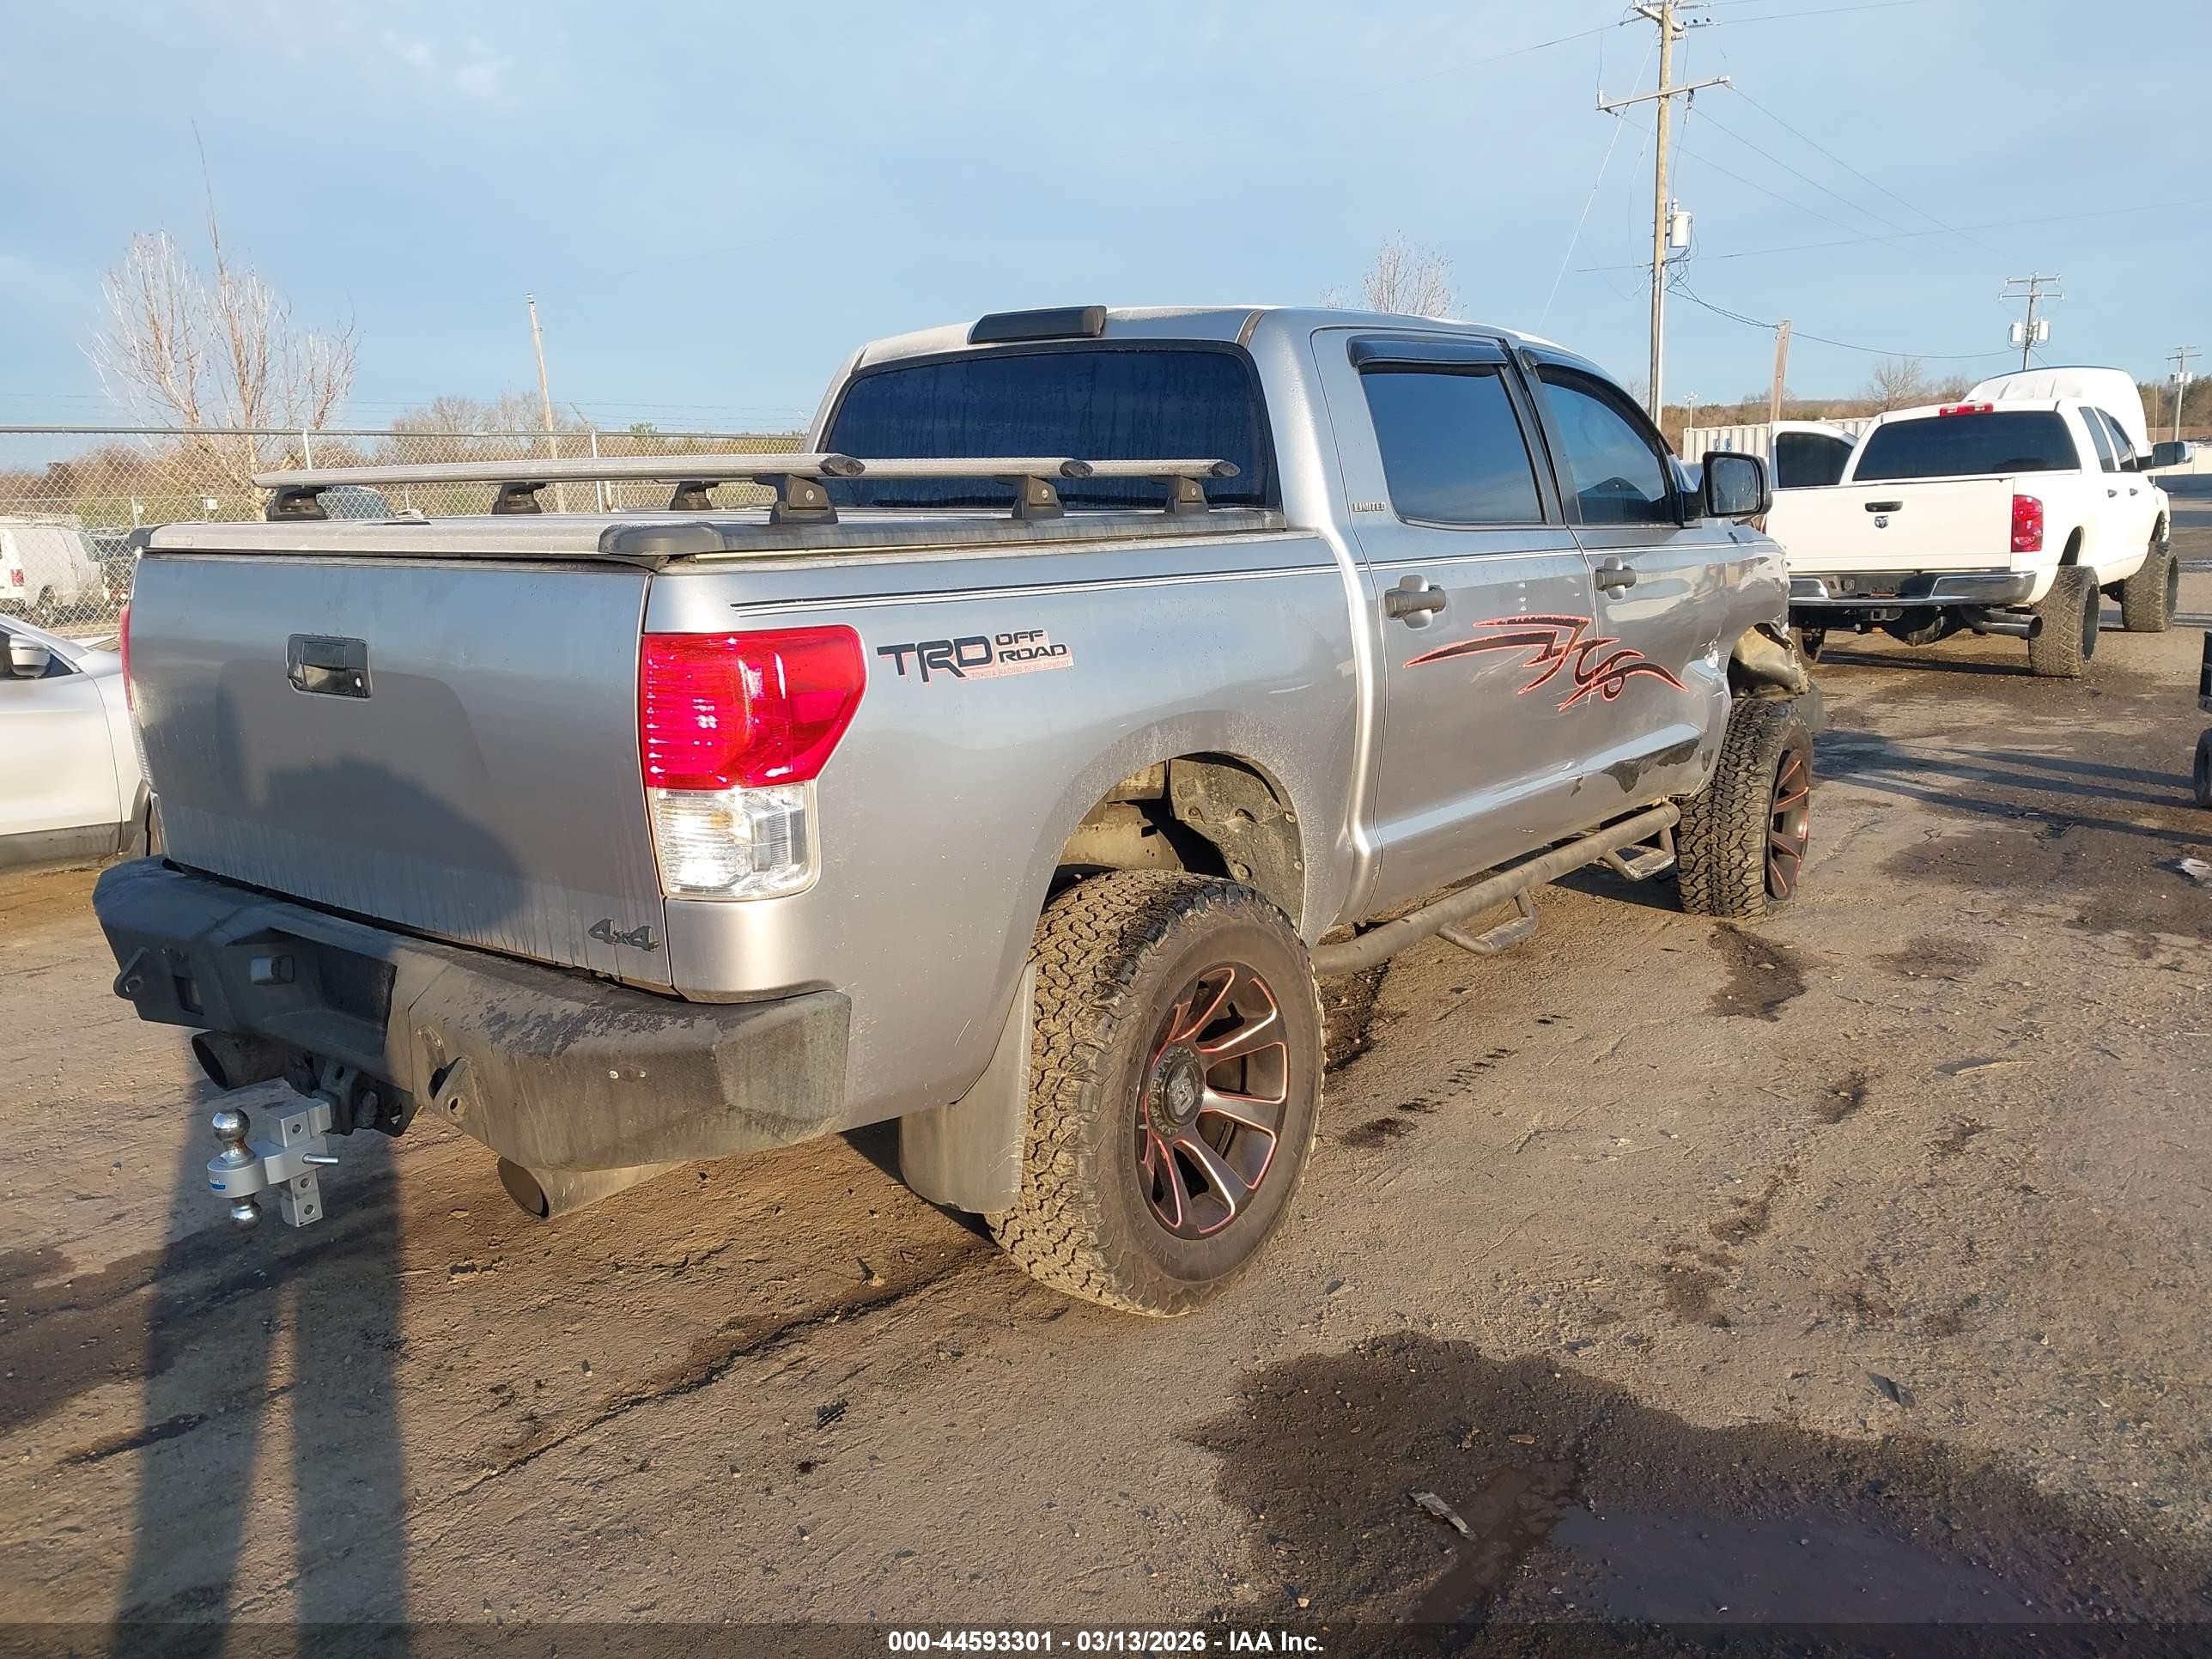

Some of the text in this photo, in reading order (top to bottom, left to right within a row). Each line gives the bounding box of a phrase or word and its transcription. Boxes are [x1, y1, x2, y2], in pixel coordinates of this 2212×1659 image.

[1353, 501, 1387, 513] LIMITED
[995, 629, 1044, 647] OFF
[877, 635, 994, 683] TRD
[998, 644, 1067, 664] ROAD
[971, 670, 997, 679] TOYOTA
